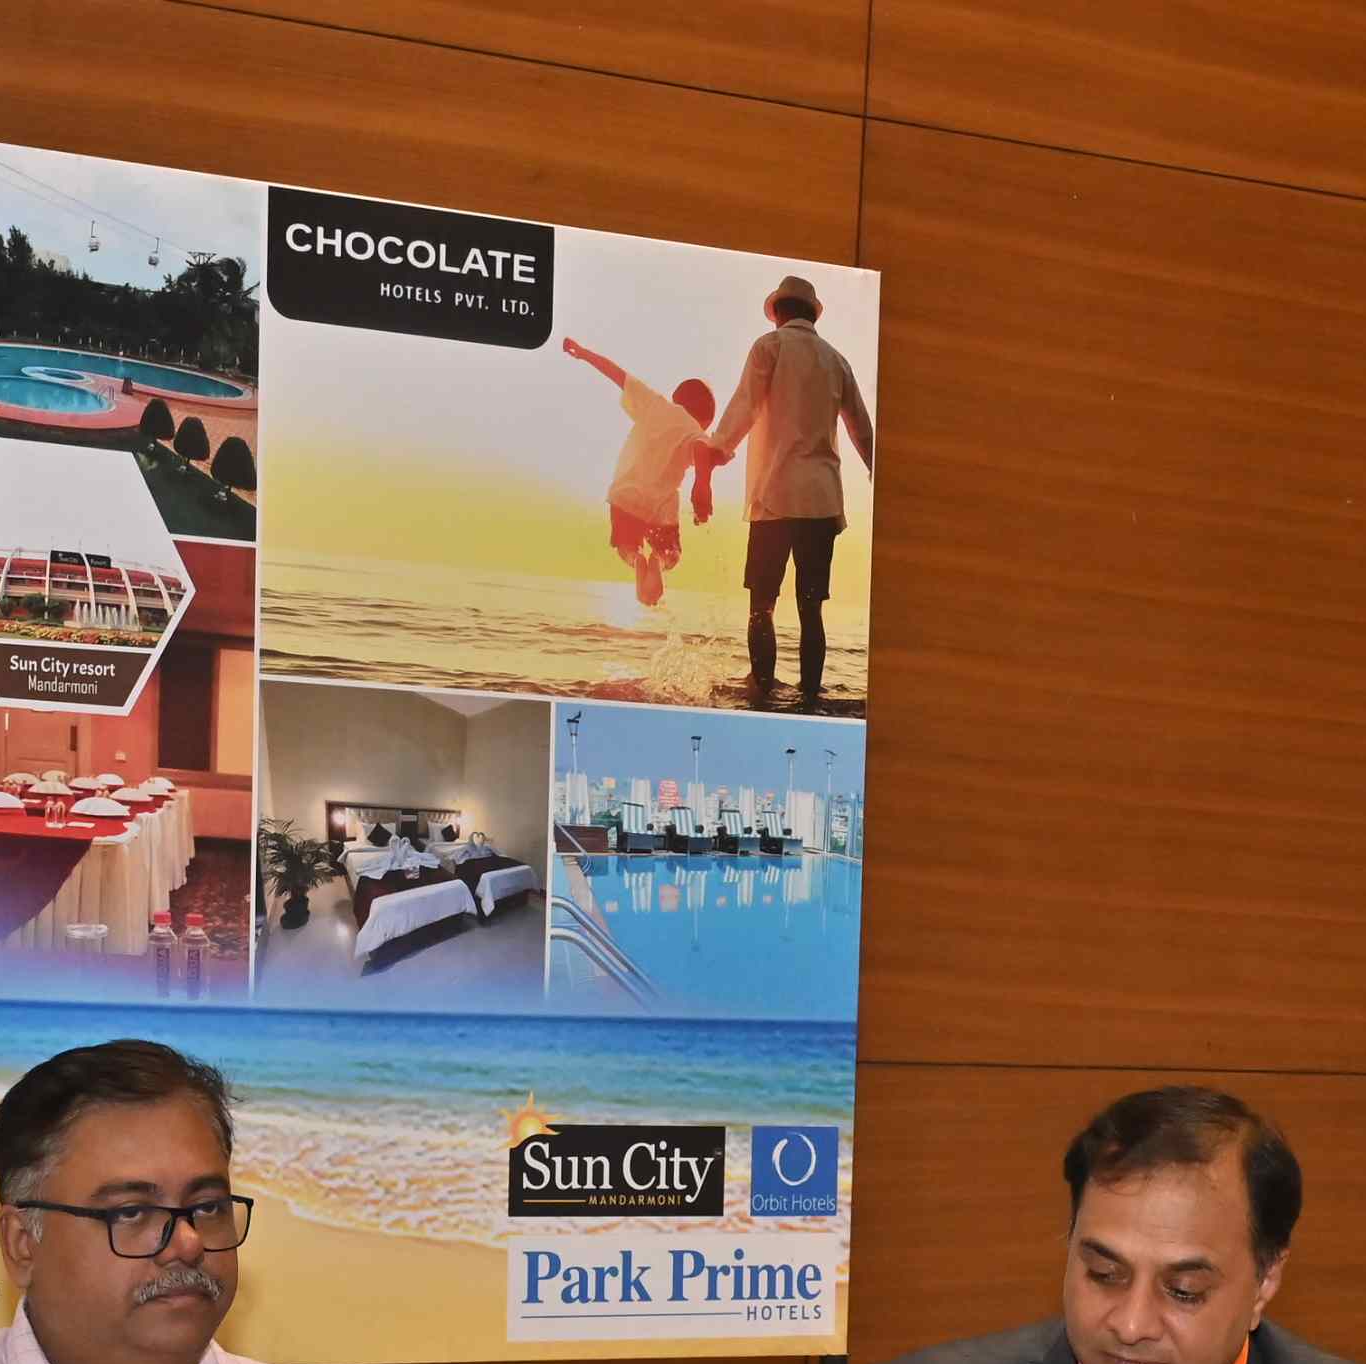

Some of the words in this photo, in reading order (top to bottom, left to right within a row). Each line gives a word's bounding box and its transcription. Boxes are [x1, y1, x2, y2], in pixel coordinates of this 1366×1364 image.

[285, 223, 536, 284] CHOCOLATE
[380, 283, 442, 304] HOTELS
[454, 292, 488, 311] PVT.
[502, 299, 535, 317] LTD.
[10, 655, 38, 672] Sun
[40, 657, 73, 679] City
[73, 660, 116, 677] resort
[28, 676, 98, 696] Mandarmoni
[522, 1141, 613, 1191] Sun
[622, 1141, 715, 1203] City
[587, 1195, 682, 1207] MANDARMONI
[752, 1194, 787, 1212] Orbit
[791, 1193, 836, 1212] Hotels
[521, 1250, 653, 1305] Park
[666, 1248, 823, 1302] Prime
[746, 1304, 822, 1321] HOTELS
